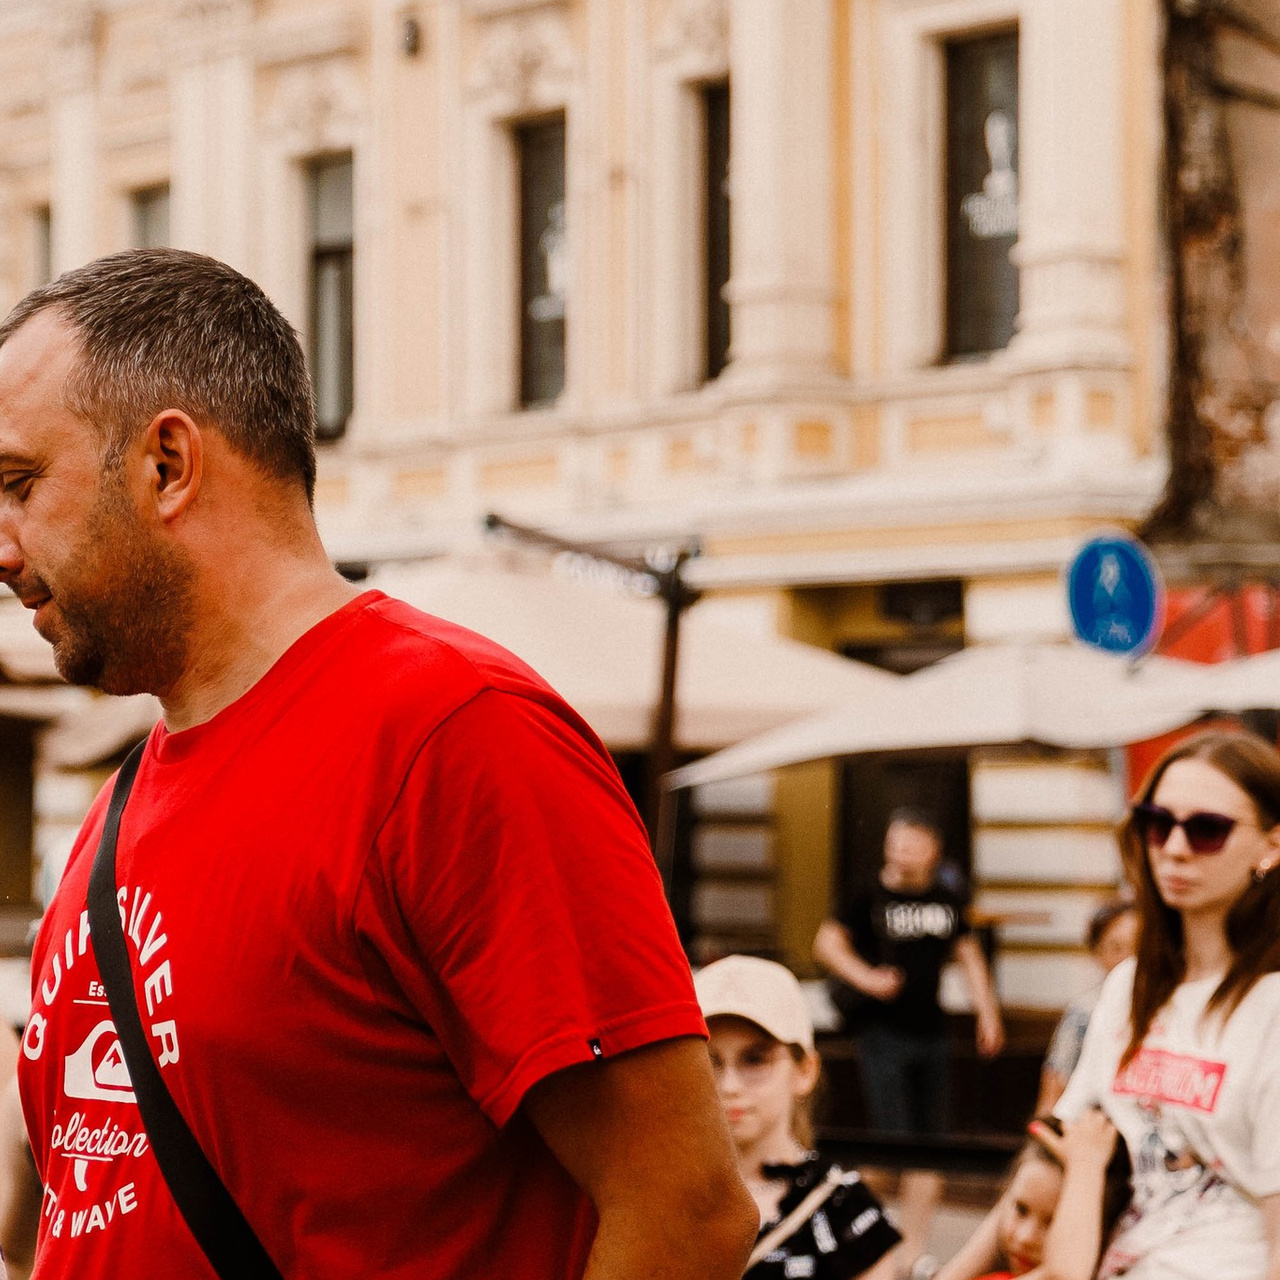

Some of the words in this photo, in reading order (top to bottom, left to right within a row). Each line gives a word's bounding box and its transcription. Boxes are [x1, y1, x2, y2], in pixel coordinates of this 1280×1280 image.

[51, 1111, 149, 1158] ollection
[52, 1209, 65, 1239] &
[71, 1182, 138, 1239] WAVE
